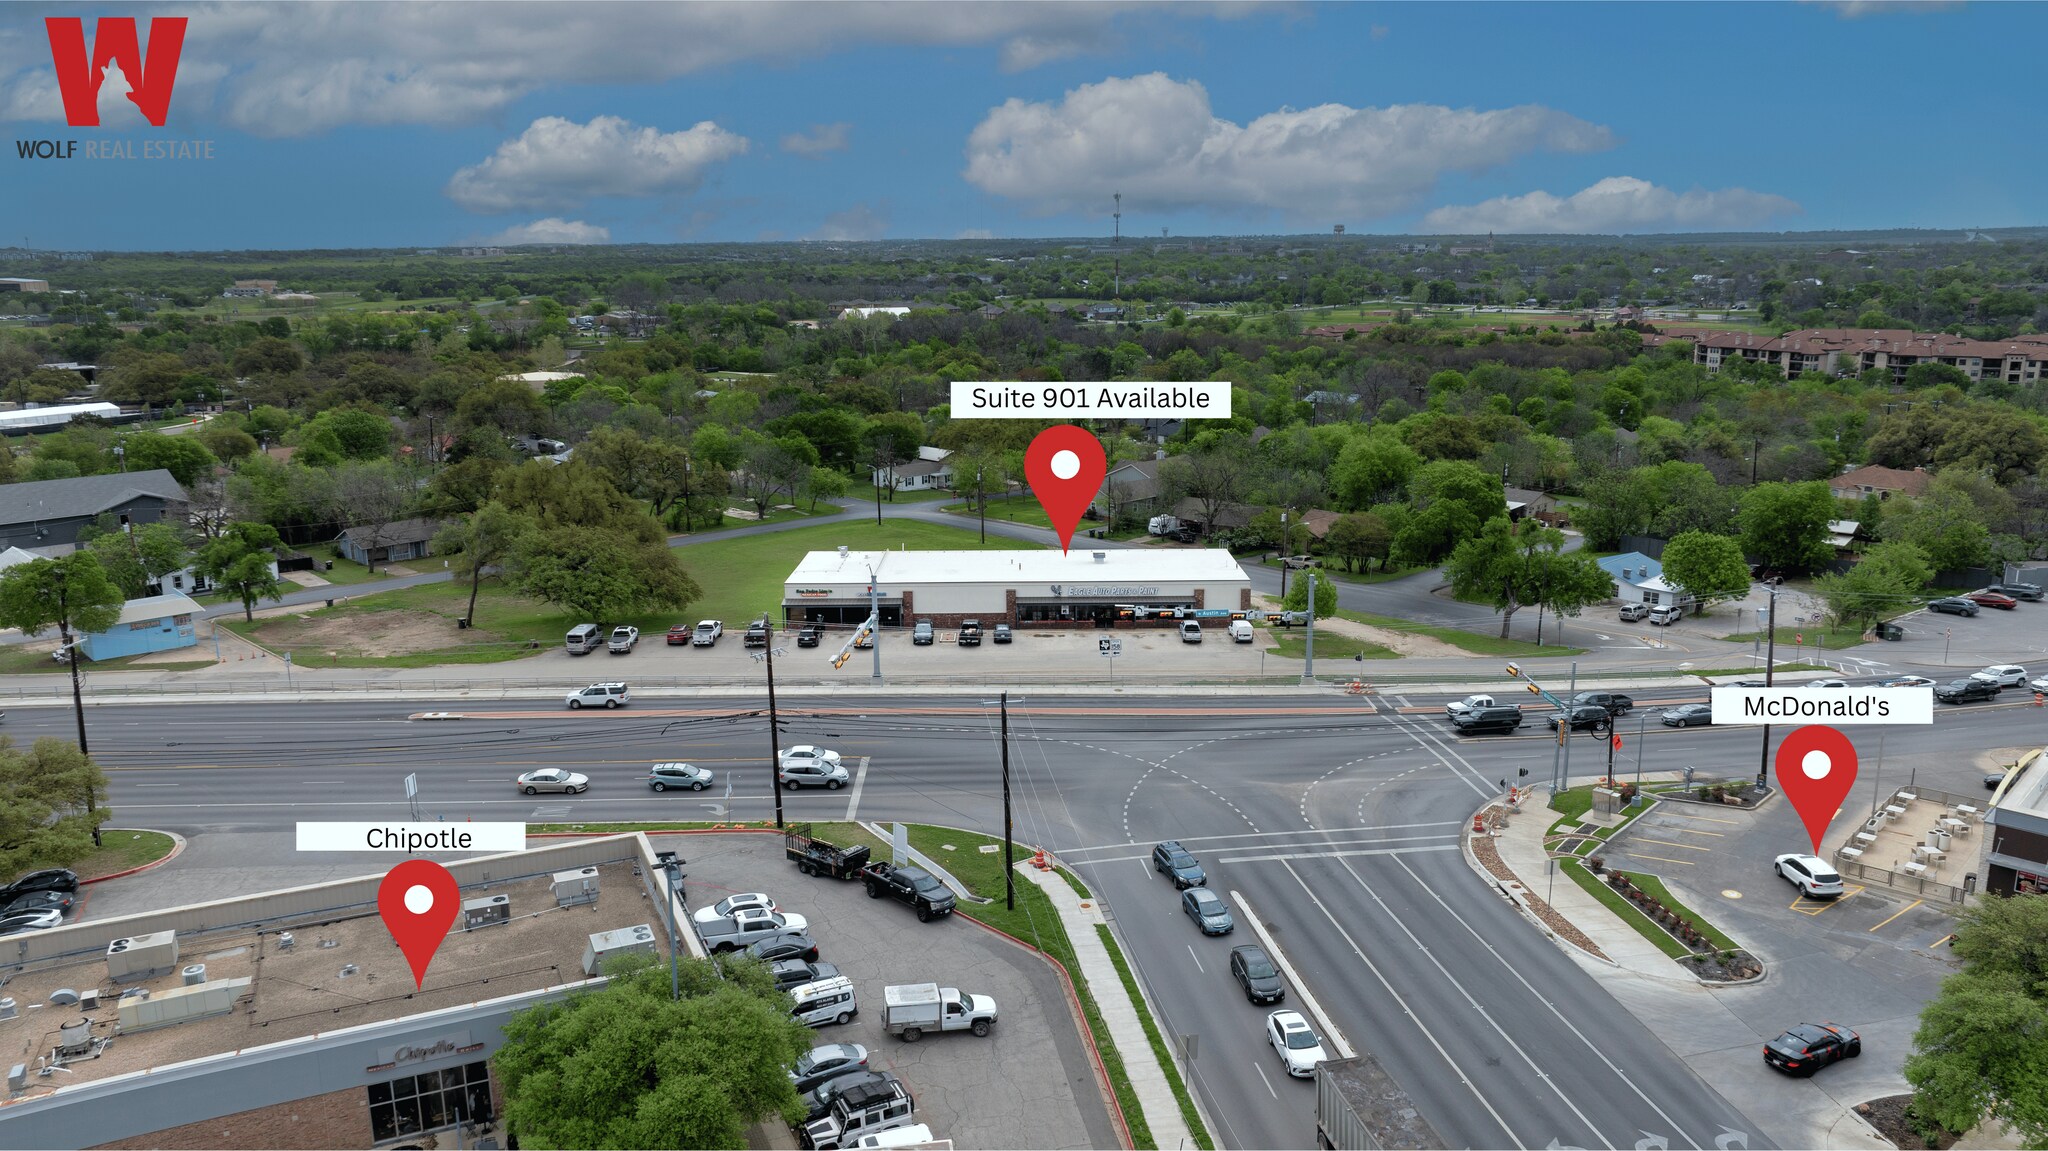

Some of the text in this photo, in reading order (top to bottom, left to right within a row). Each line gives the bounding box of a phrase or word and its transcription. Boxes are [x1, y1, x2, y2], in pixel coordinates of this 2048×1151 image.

[1111, 586, 1132, 596] PARTS
[1138, 586, 1160, 596] PAINT
[394, 1040, 455, 1062] Chipotle
